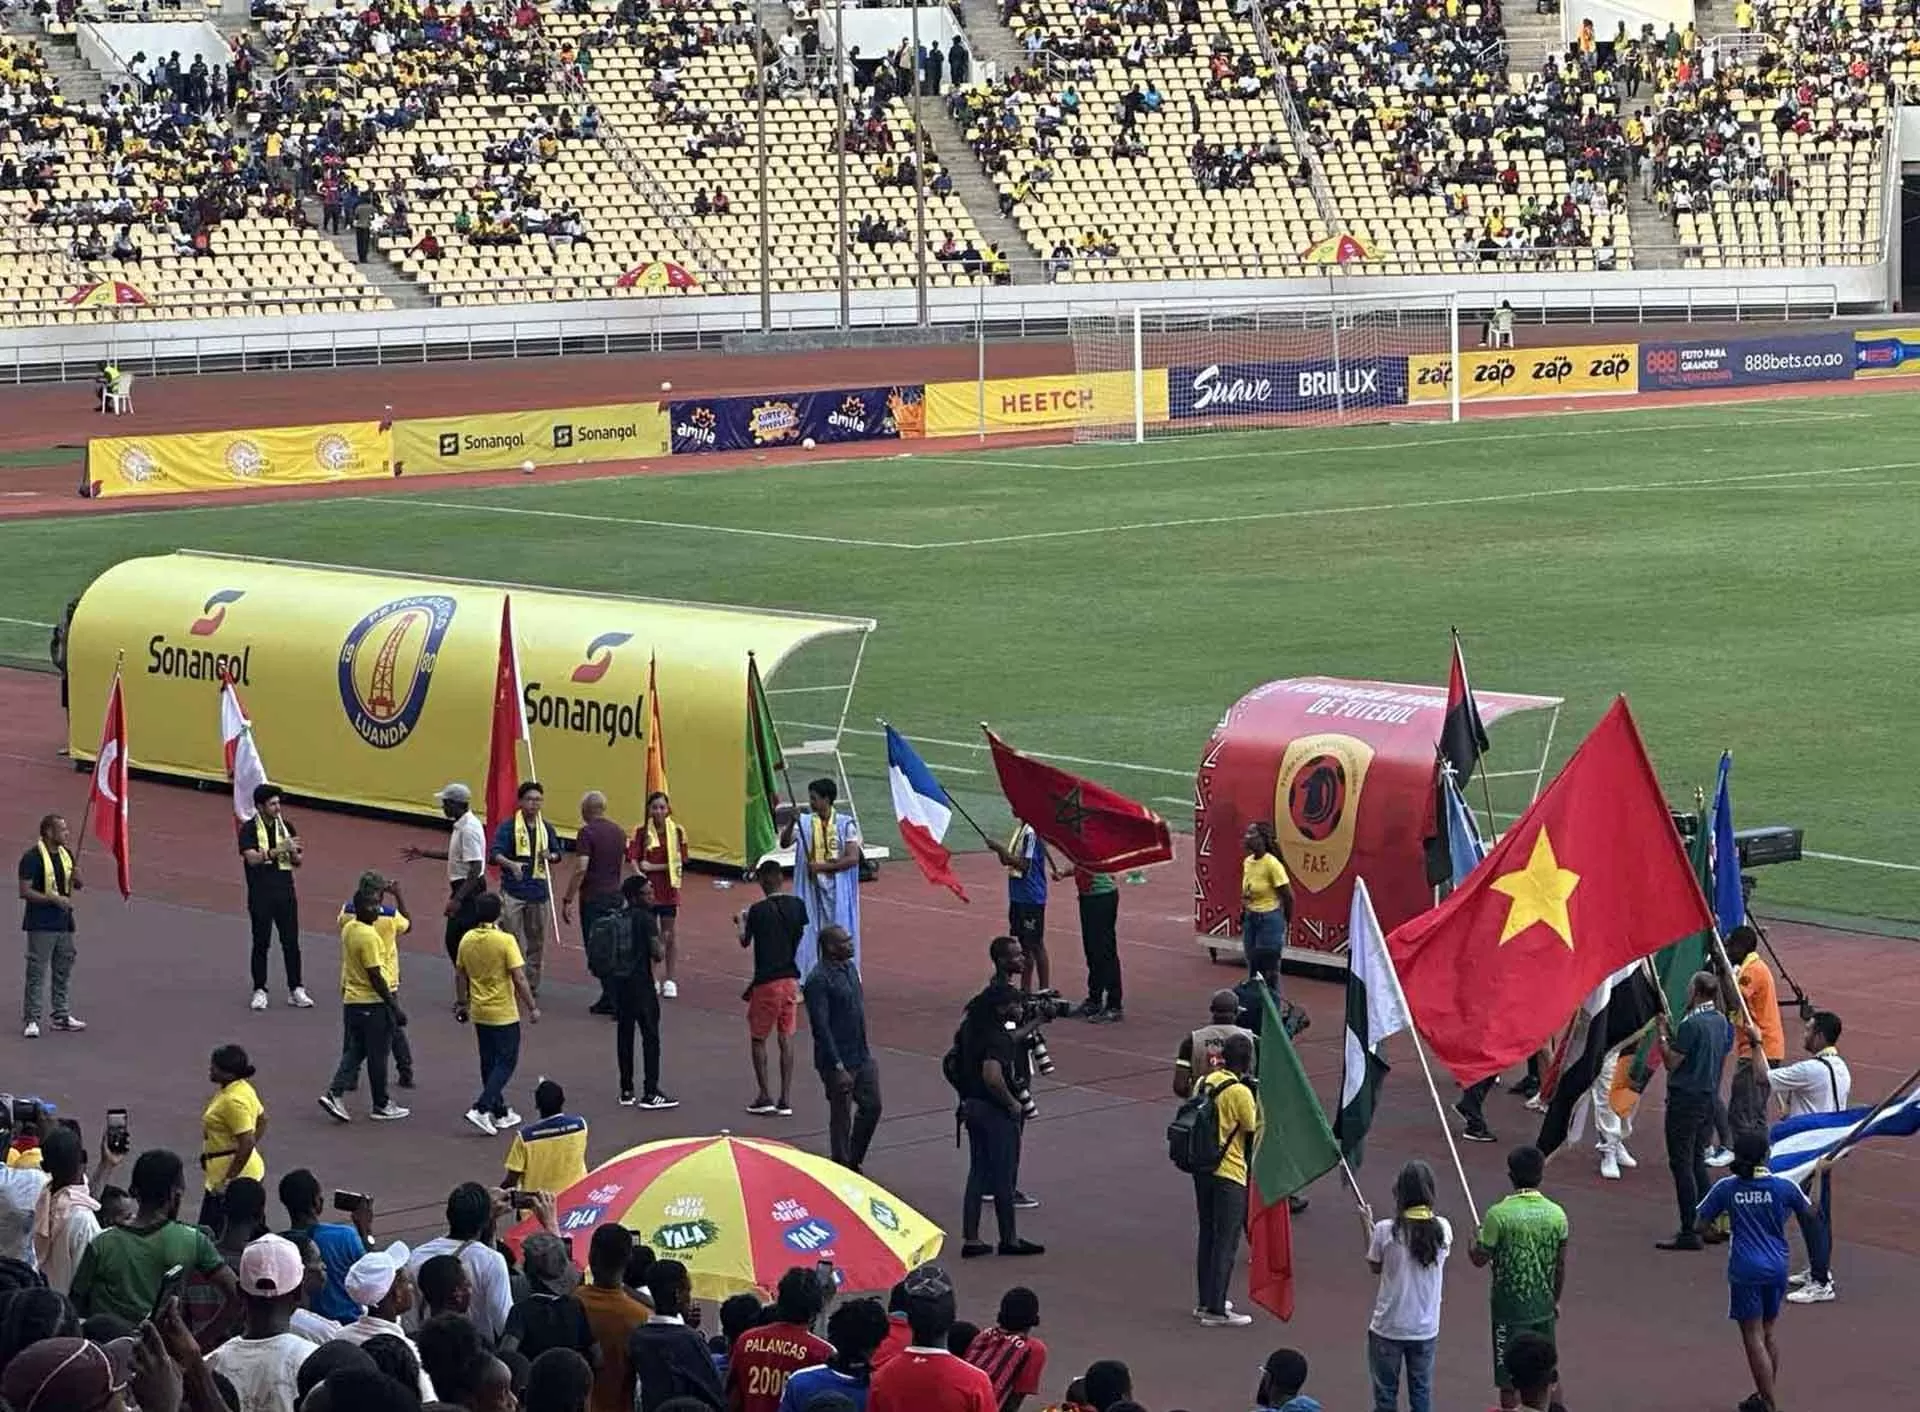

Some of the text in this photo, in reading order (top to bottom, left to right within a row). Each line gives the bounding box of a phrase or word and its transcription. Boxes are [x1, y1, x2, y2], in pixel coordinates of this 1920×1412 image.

[1704, 348, 1727, 358] PARA
[1745, 352, 1843, 372] 888bets.co.ao
[1193, 365, 1272, 410] Suave
[1299, 369, 1378, 397] BRILUX
[1002, 389, 1093, 414] HEETCH
[464, 424, 637, 453] Sonangol Sonangol
[148, 634, 250, 687] Sonangol
[342, 644, 355, 663] 19
[421, 652, 436, 672] 80
[523, 682, 644, 747] Sonangol
[1305, 696, 1338, 715] DE
[1332, 698, 1418, 724] FUTEBOL
[355, 712, 408, 746] LUANDA
[1734, 1191, 1773, 1204] CUBA
[565, 1208, 598, 1230] YALA
[661, 1223, 707, 1249] YALA
[787, 1221, 830, 1249] YALA
[744, 1337, 807, 1361] PALANCAS
